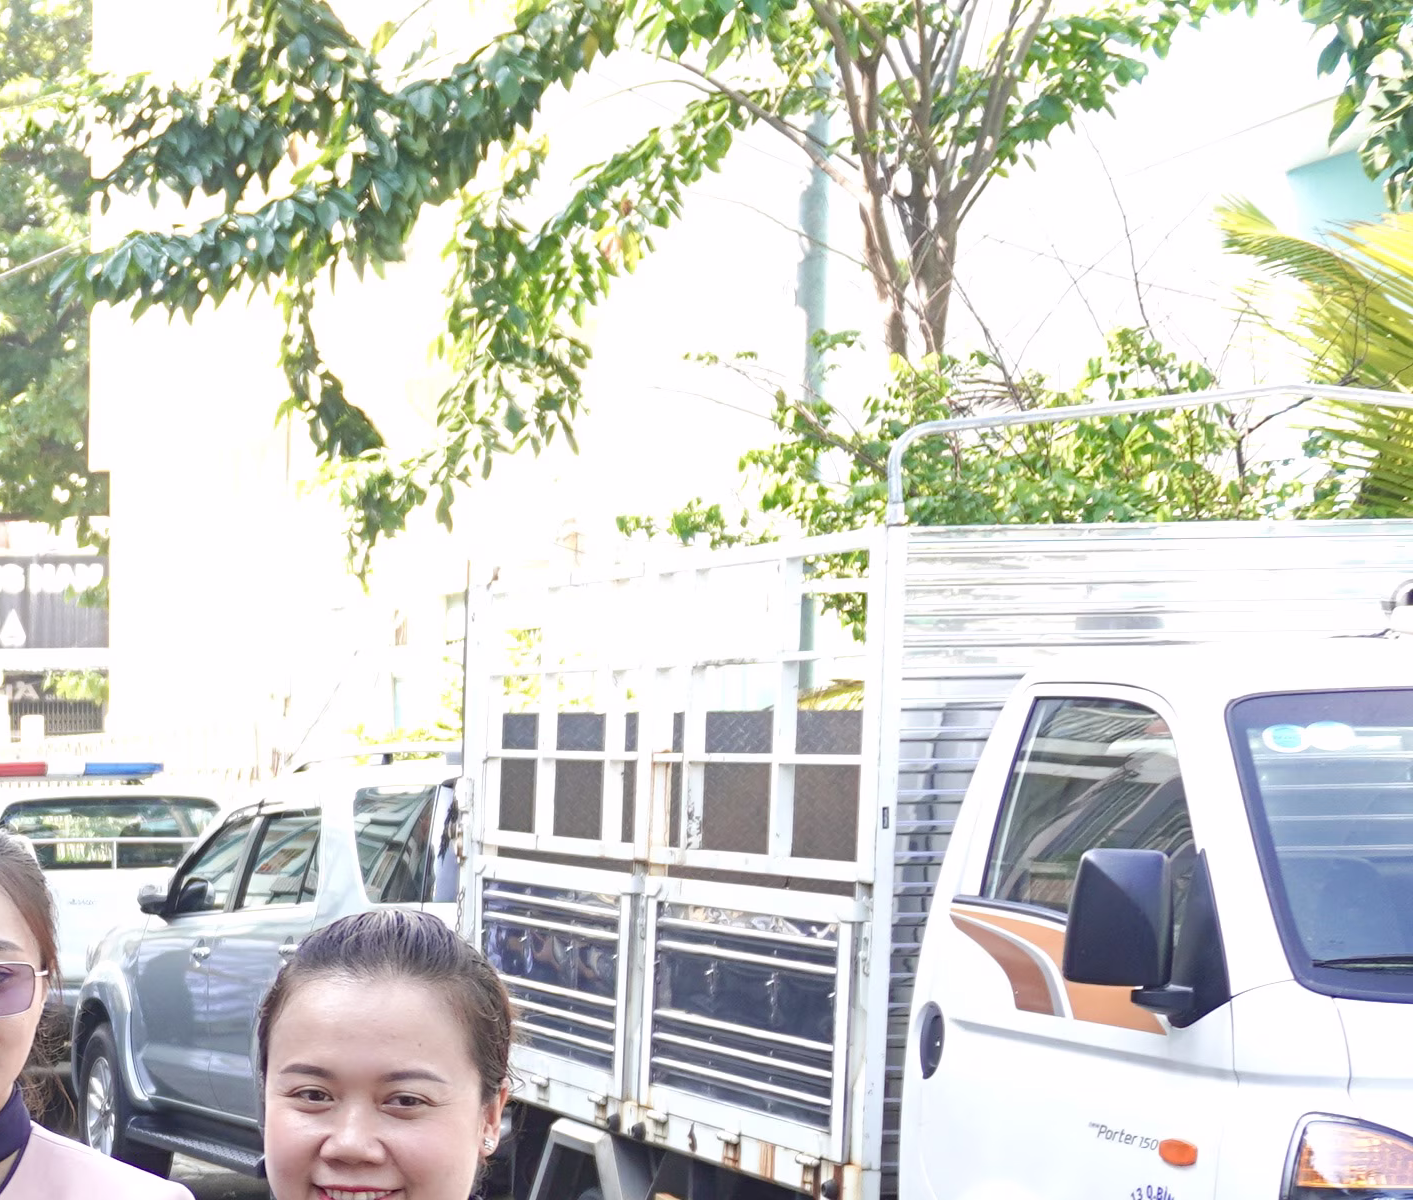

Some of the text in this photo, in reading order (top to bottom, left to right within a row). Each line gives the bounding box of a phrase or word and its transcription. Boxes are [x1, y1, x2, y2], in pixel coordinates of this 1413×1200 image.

[29, 563, 104, 594] NAM
[1097, 1124, 1138, 1146] Porter
[1139, 1136, 1159, 1151] 150
